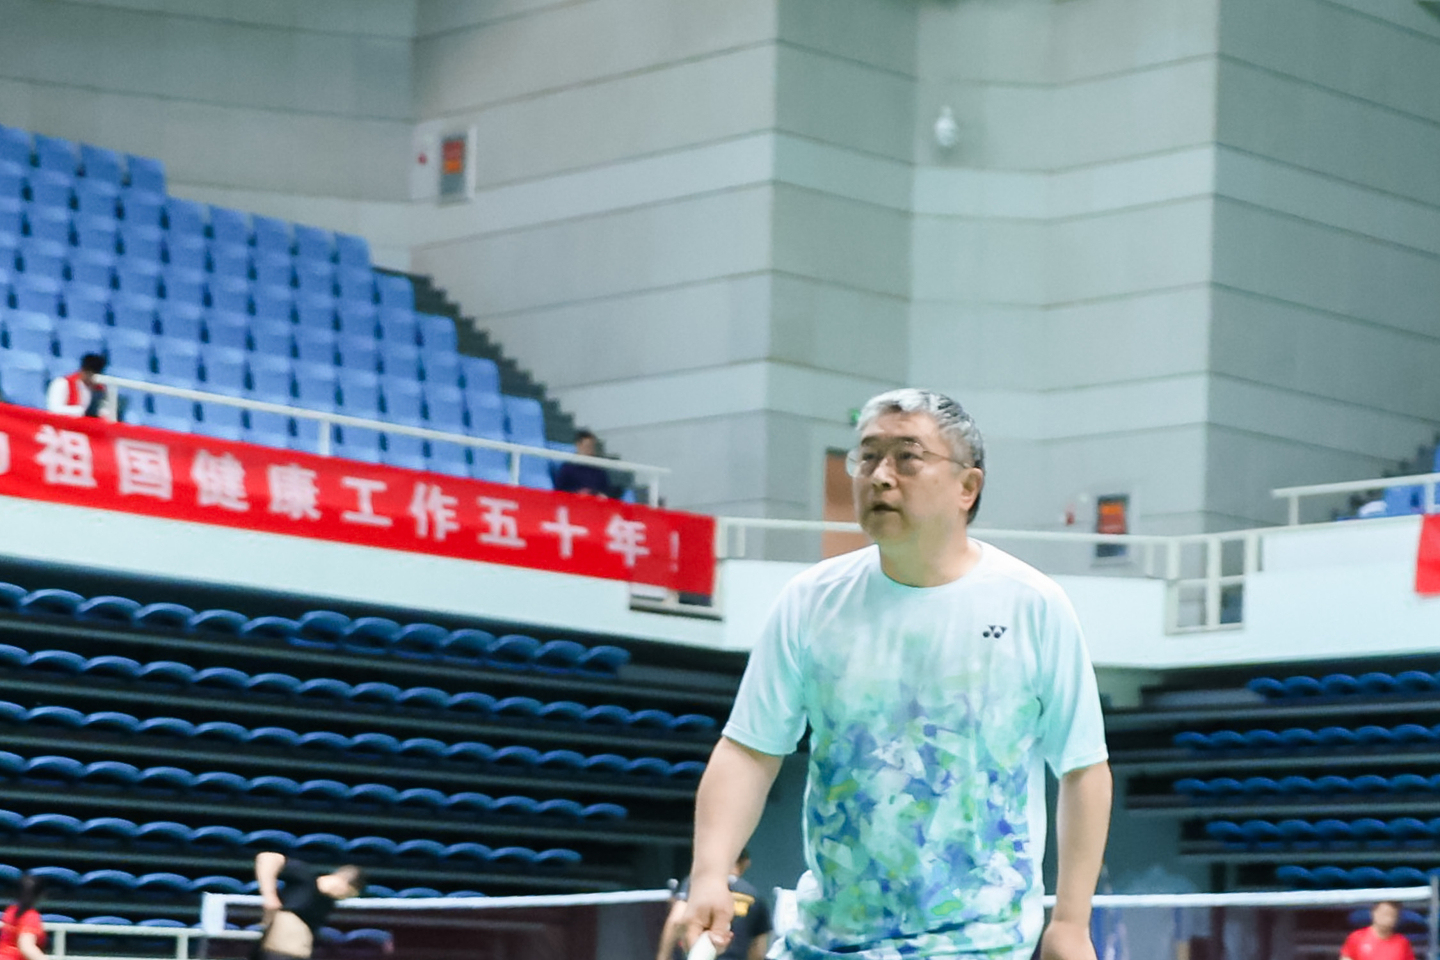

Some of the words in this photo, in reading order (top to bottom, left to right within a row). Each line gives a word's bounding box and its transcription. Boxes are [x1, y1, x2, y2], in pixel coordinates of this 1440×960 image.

[0, 424, 680, 573] 祖国健康工作五十年！
